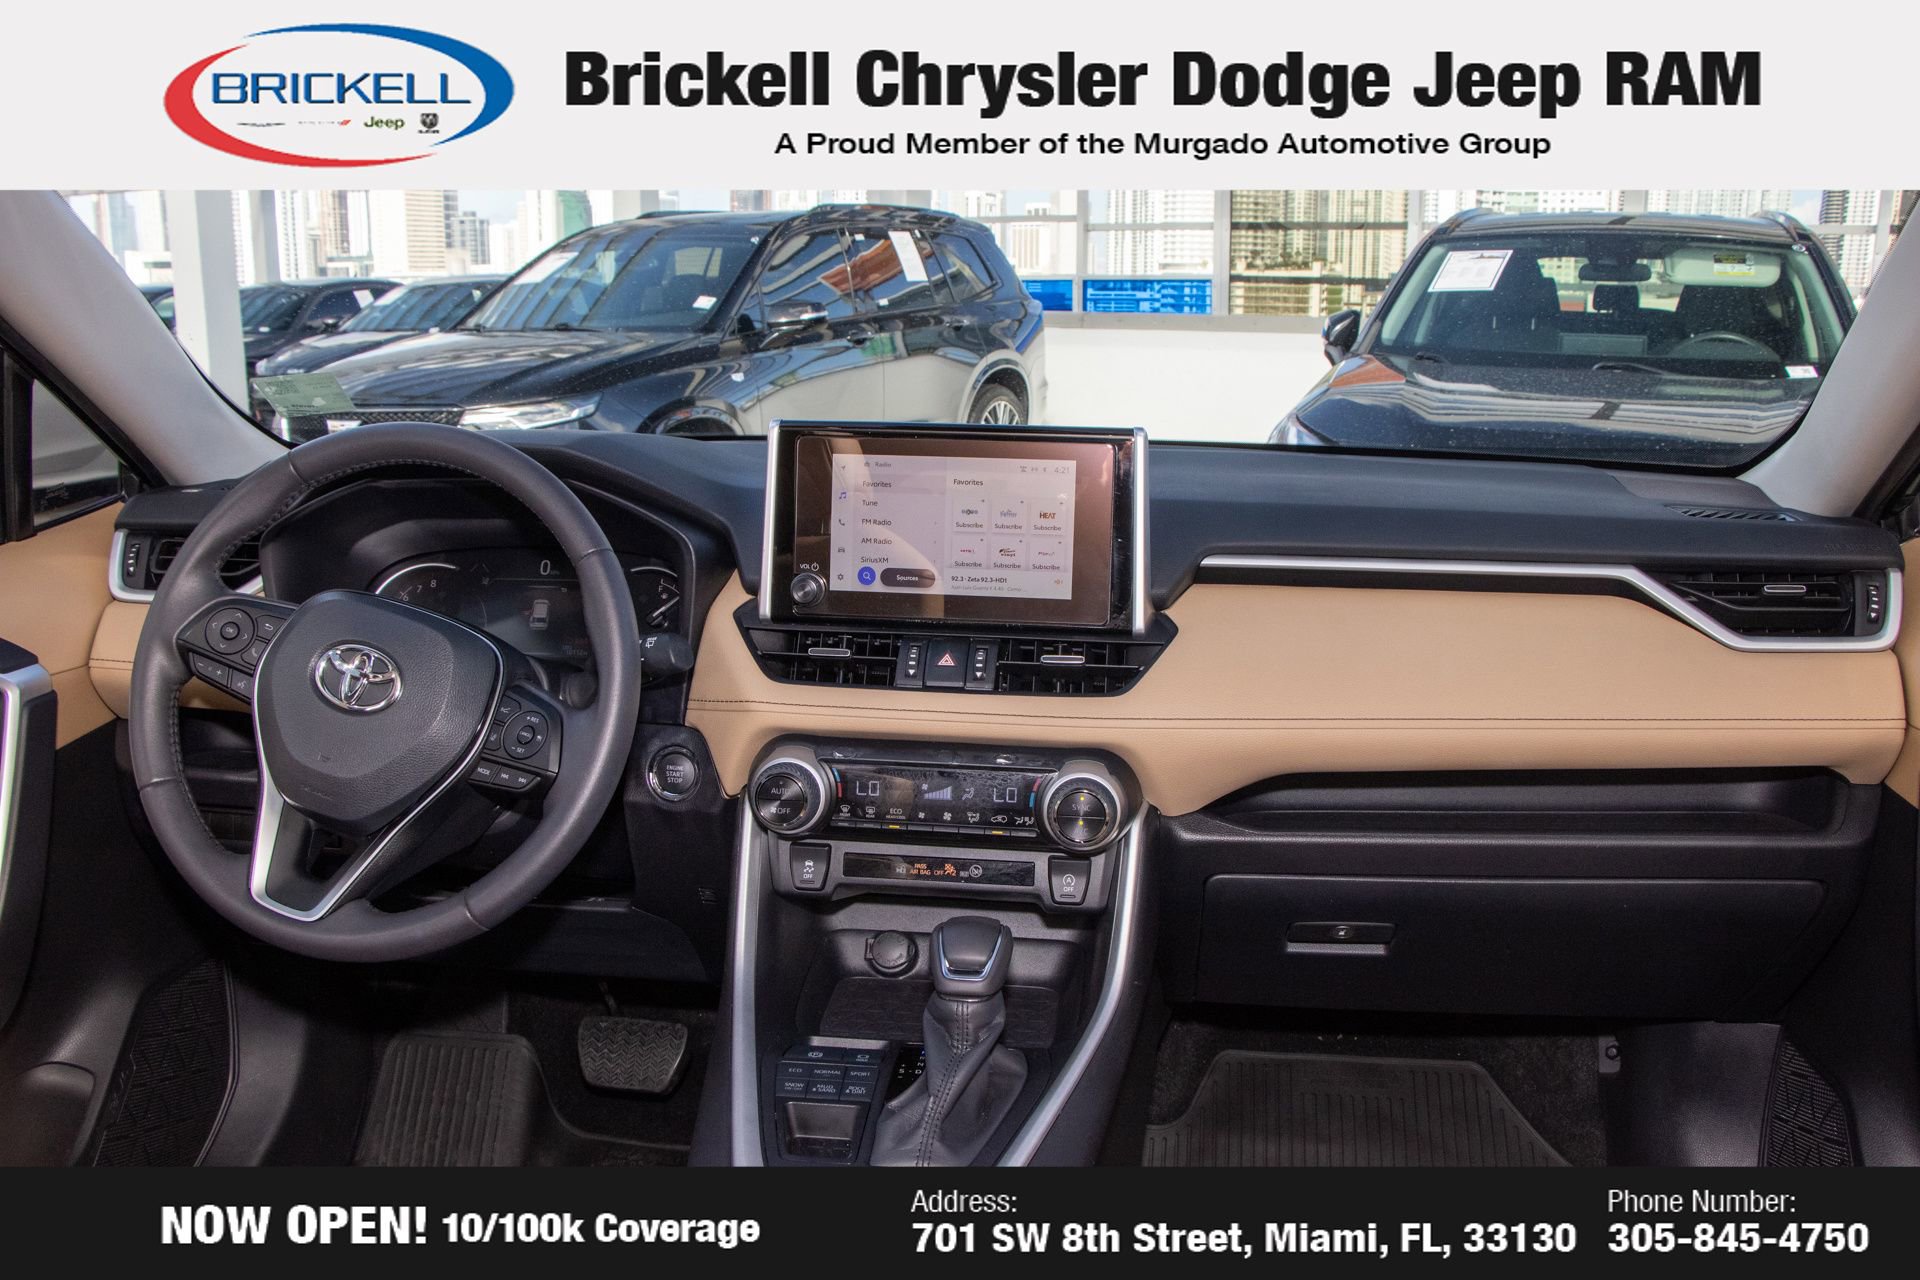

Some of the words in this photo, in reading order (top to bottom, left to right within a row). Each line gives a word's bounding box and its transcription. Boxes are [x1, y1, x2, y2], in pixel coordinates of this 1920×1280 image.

[1054, 466, 1069, 474] 4:21
[953, 479, 983, 487] Favorites
[955, 521, 983, 529] Subscribe
[1033, 524, 1061, 532] Subscribe
[540, 560, 550, 575] 0
[954, 560, 982, 568] Subscribe
[430, 579, 437, 588] 8
[416, 585, 423, 593] 7
[770, 788, 791, 796] AUTO
